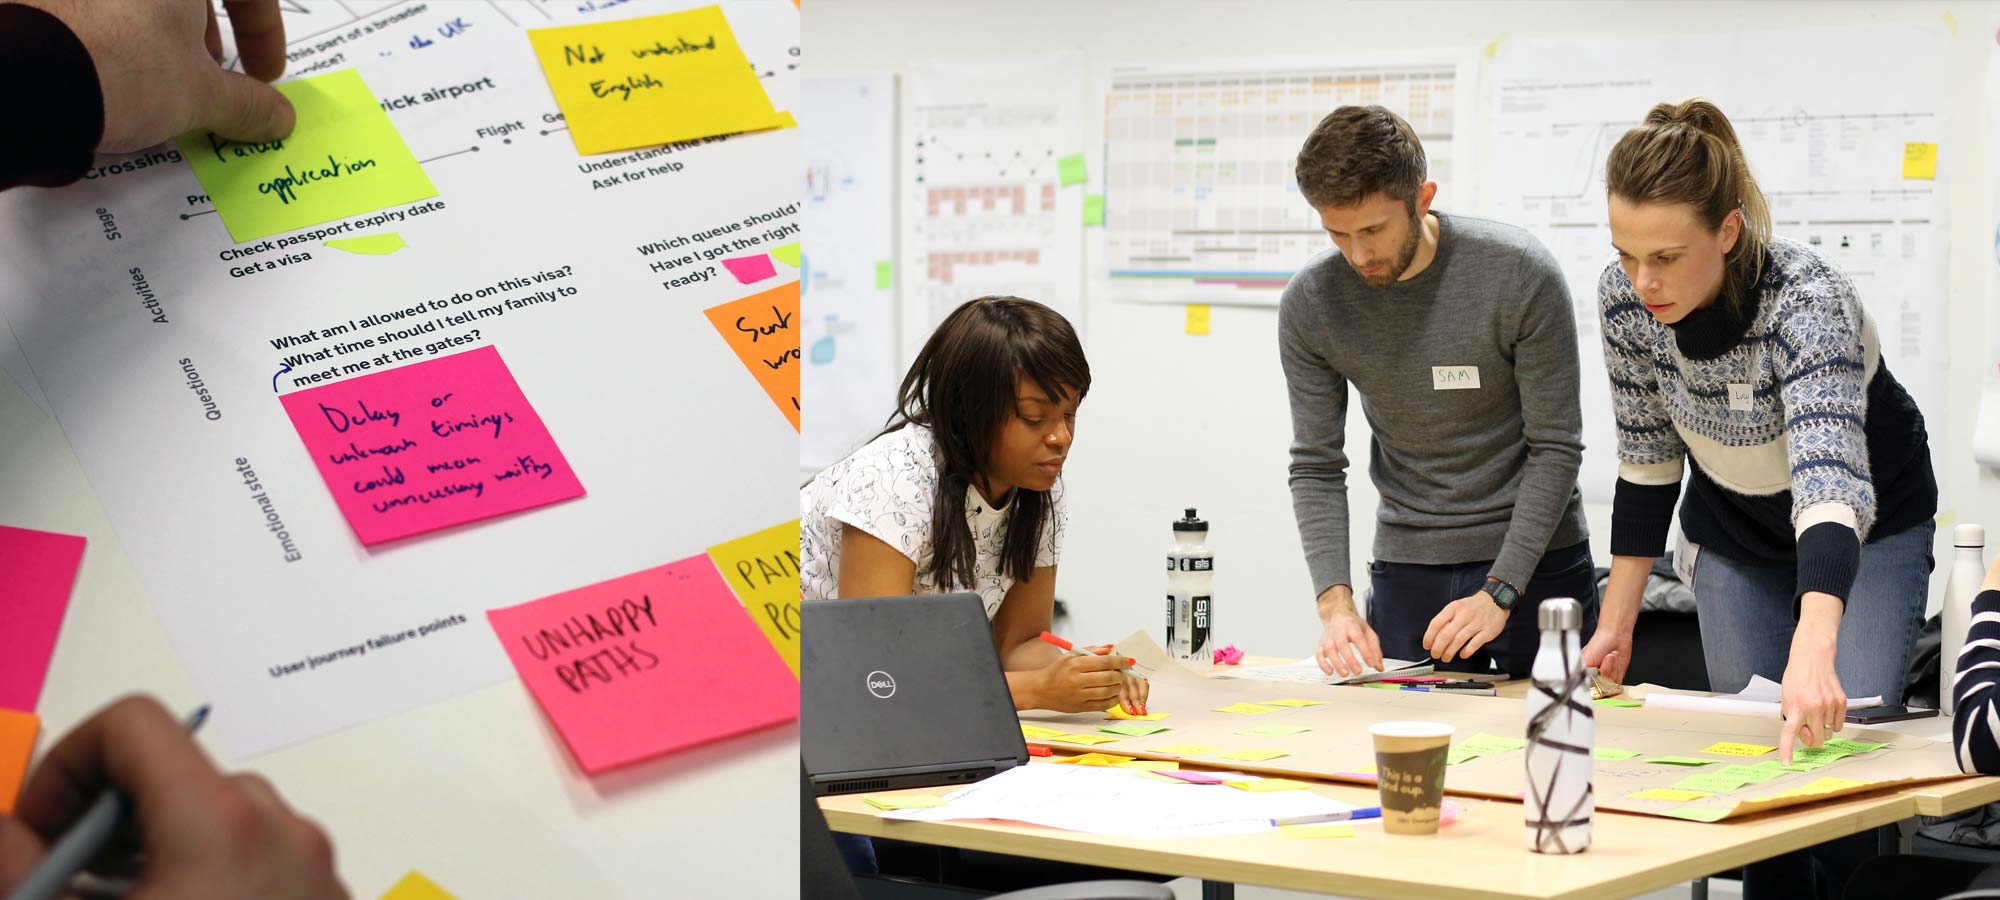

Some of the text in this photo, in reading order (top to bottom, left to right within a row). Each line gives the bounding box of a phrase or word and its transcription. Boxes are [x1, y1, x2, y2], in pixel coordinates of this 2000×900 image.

[315, 35, 346, 52] part
[346, 27, 363, 40] of
[363, 26, 372, 35] a
[372, 4, 428, 31] broader
[437, 17, 473, 38] UK
[421, 77, 496, 98] airport
[590, 73, 663, 102] English
[476, 119, 525, 139] Flight
[578, 144, 673, 174] Understand
[591, 160, 684, 190] Ask for help
[258, 155, 376, 205] application
[95, 207, 122, 241] Stage
[219, 200, 445, 262] Check passport expiry date
[637, 203, 798, 256] Which queue should
[229, 251, 313, 279] Get a visa
[650, 222, 800, 274] Have I got the right
[129, 267, 169, 324] Activities
[663, 266, 717, 290] ready?
[270, 265, 573, 351] What am I allowed to do on this visa?
[284, 284, 578, 368] What time should I tell my family to
[293, 328, 482, 388] meet me at the gates?
[1439, 369, 1471, 382] SAM
[179, 357, 222, 421] Questions
[319, 393, 453, 433] Delay or
[431, 412, 514, 439] timings
[354, 457, 481, 494] could mean
[235, 456, 302, 563] Emotional state
[268, 613, 467, 678] User journey failure points
[521, 594, 658, 661] UNHAPPY
[555, 641, 659, 694] PATHS
[870, 680, 893, 689] DELL
[1402, 770, 1412, 784] is
[1413, 775, 1423, 783] a
